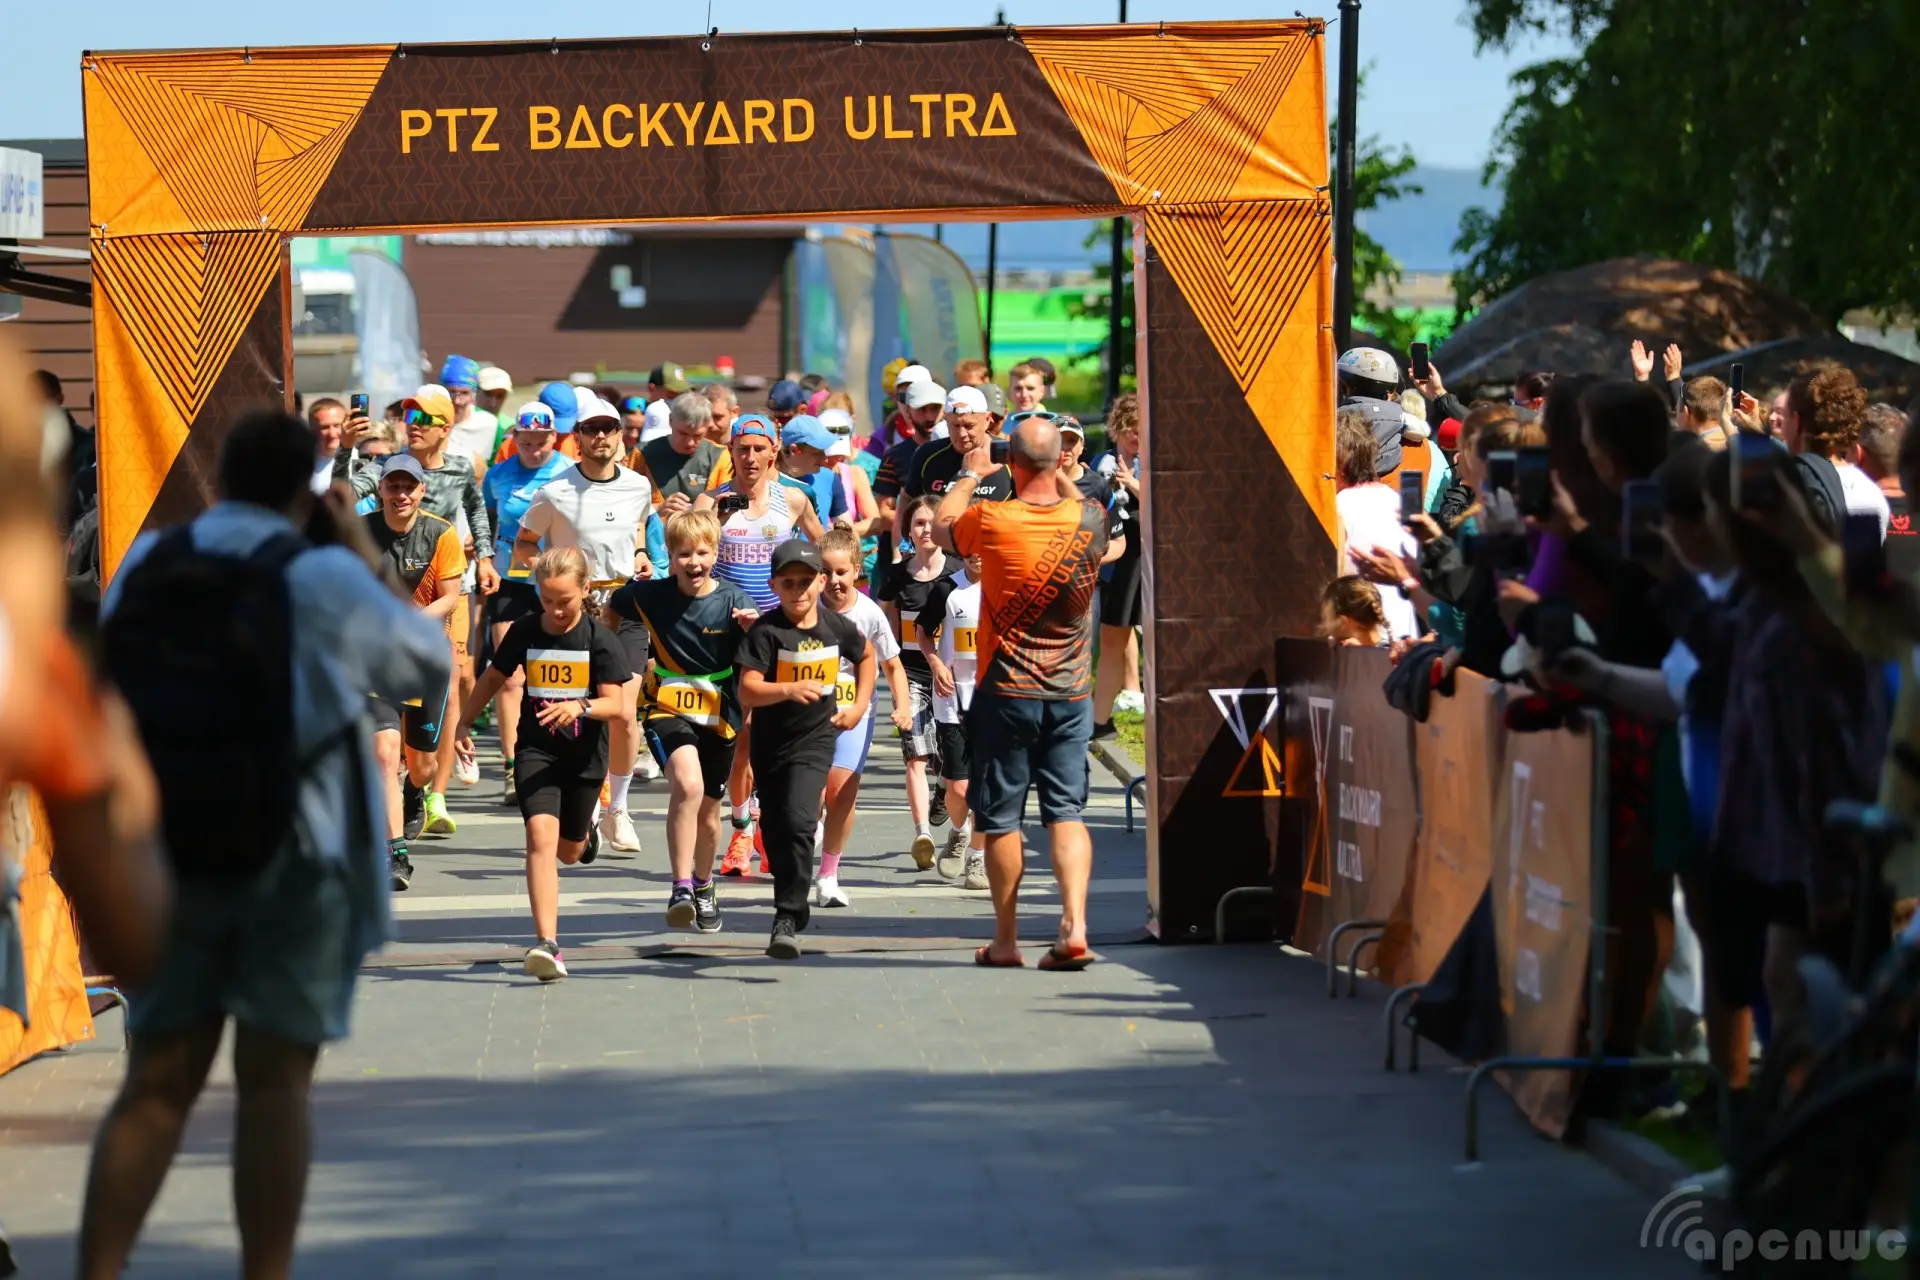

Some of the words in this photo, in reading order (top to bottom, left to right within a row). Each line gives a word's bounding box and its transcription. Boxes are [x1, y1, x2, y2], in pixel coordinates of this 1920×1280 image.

[401, 107, 500, 154] PTZ
[529, 98, 816, 150] BACKYARD
[844, 92, 1017, 141] ULTRA
[966, 631, 977, 648] 1
[541, 664, 573, 684] 103
[792, 664, 826, 683] 104
[675, 690, 704, 710] 101
